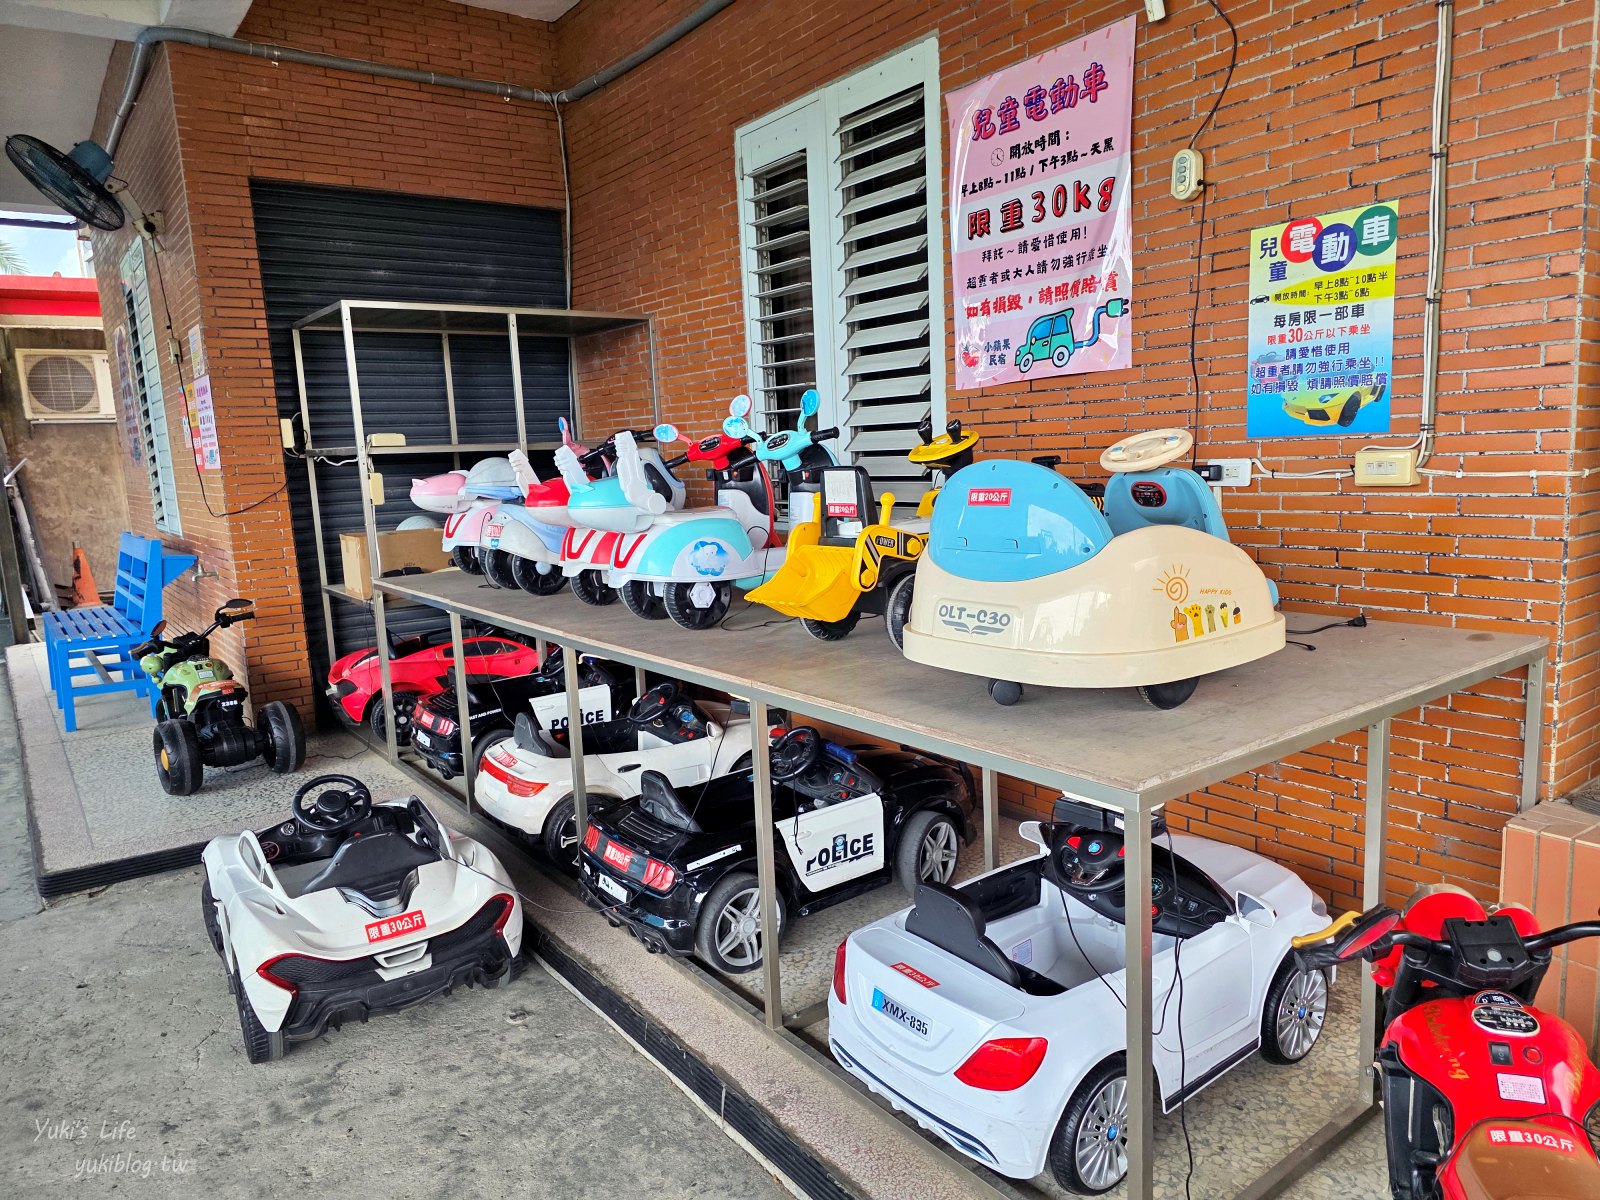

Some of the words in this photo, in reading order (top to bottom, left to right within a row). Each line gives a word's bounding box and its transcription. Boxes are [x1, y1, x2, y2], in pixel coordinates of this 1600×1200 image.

[972, 62, 1108, 141] 兒童電動車
[1273, 304, 1365, 329] 每房限一部車
[1267, 324, 1371, 346] 限重30公斤以下乘坐
[989, 354, 1007, 366] 民宿
[1285, 342, 1350, 361] 請愛惜使用
[938, 605, 1011, 627] OLT-C30
[551, 709, 604, 729] POICE
[368, 913, 423, 940] 限重30公斤
[882, 998, 929, 1036] XMX-835
[1489, 1129, 1574, 1152] 限重30公斤
